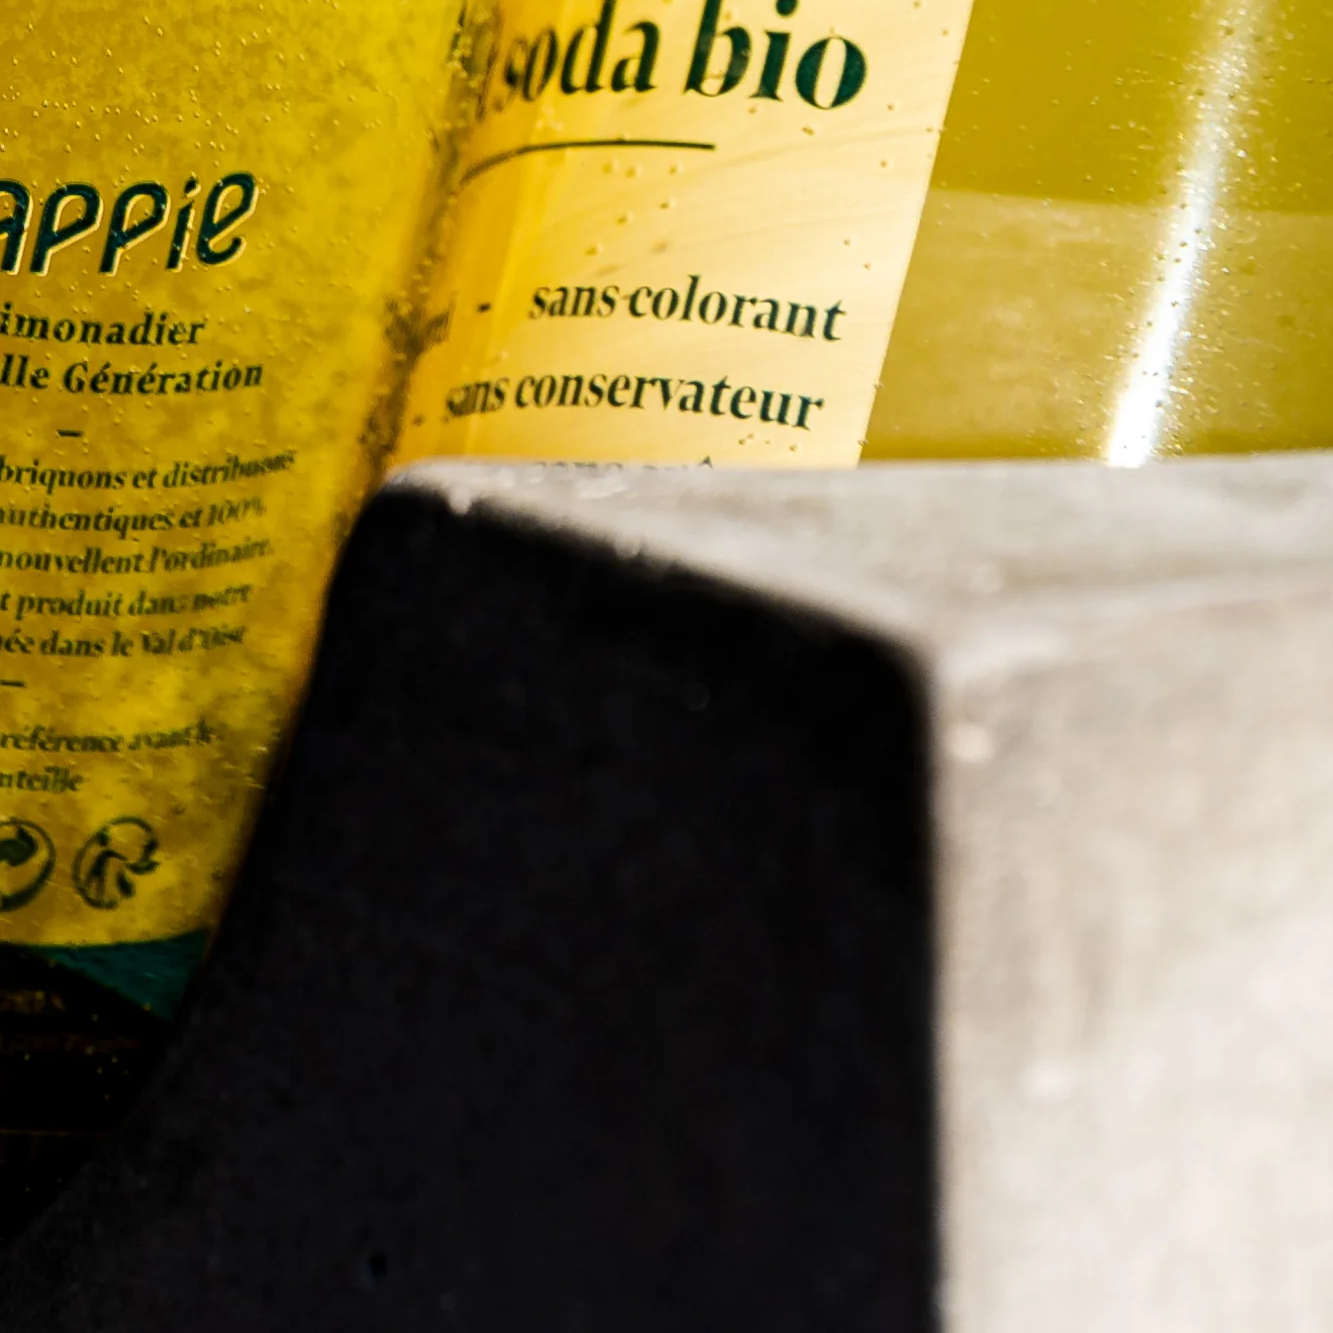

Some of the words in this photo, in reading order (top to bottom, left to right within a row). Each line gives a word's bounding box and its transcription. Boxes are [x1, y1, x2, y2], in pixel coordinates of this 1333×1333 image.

[528, 283, 621, 321] sans
[628, 274, 849, 343] colorant
[62, 360, 264, 396] Génération
[514, 373, 826, 432] conservateur
[131, 467, 158, 489] et
[179, 507, 204, 529] et
[15, 589, 122, 622] produit
[39, 630, 106, 657] dans
